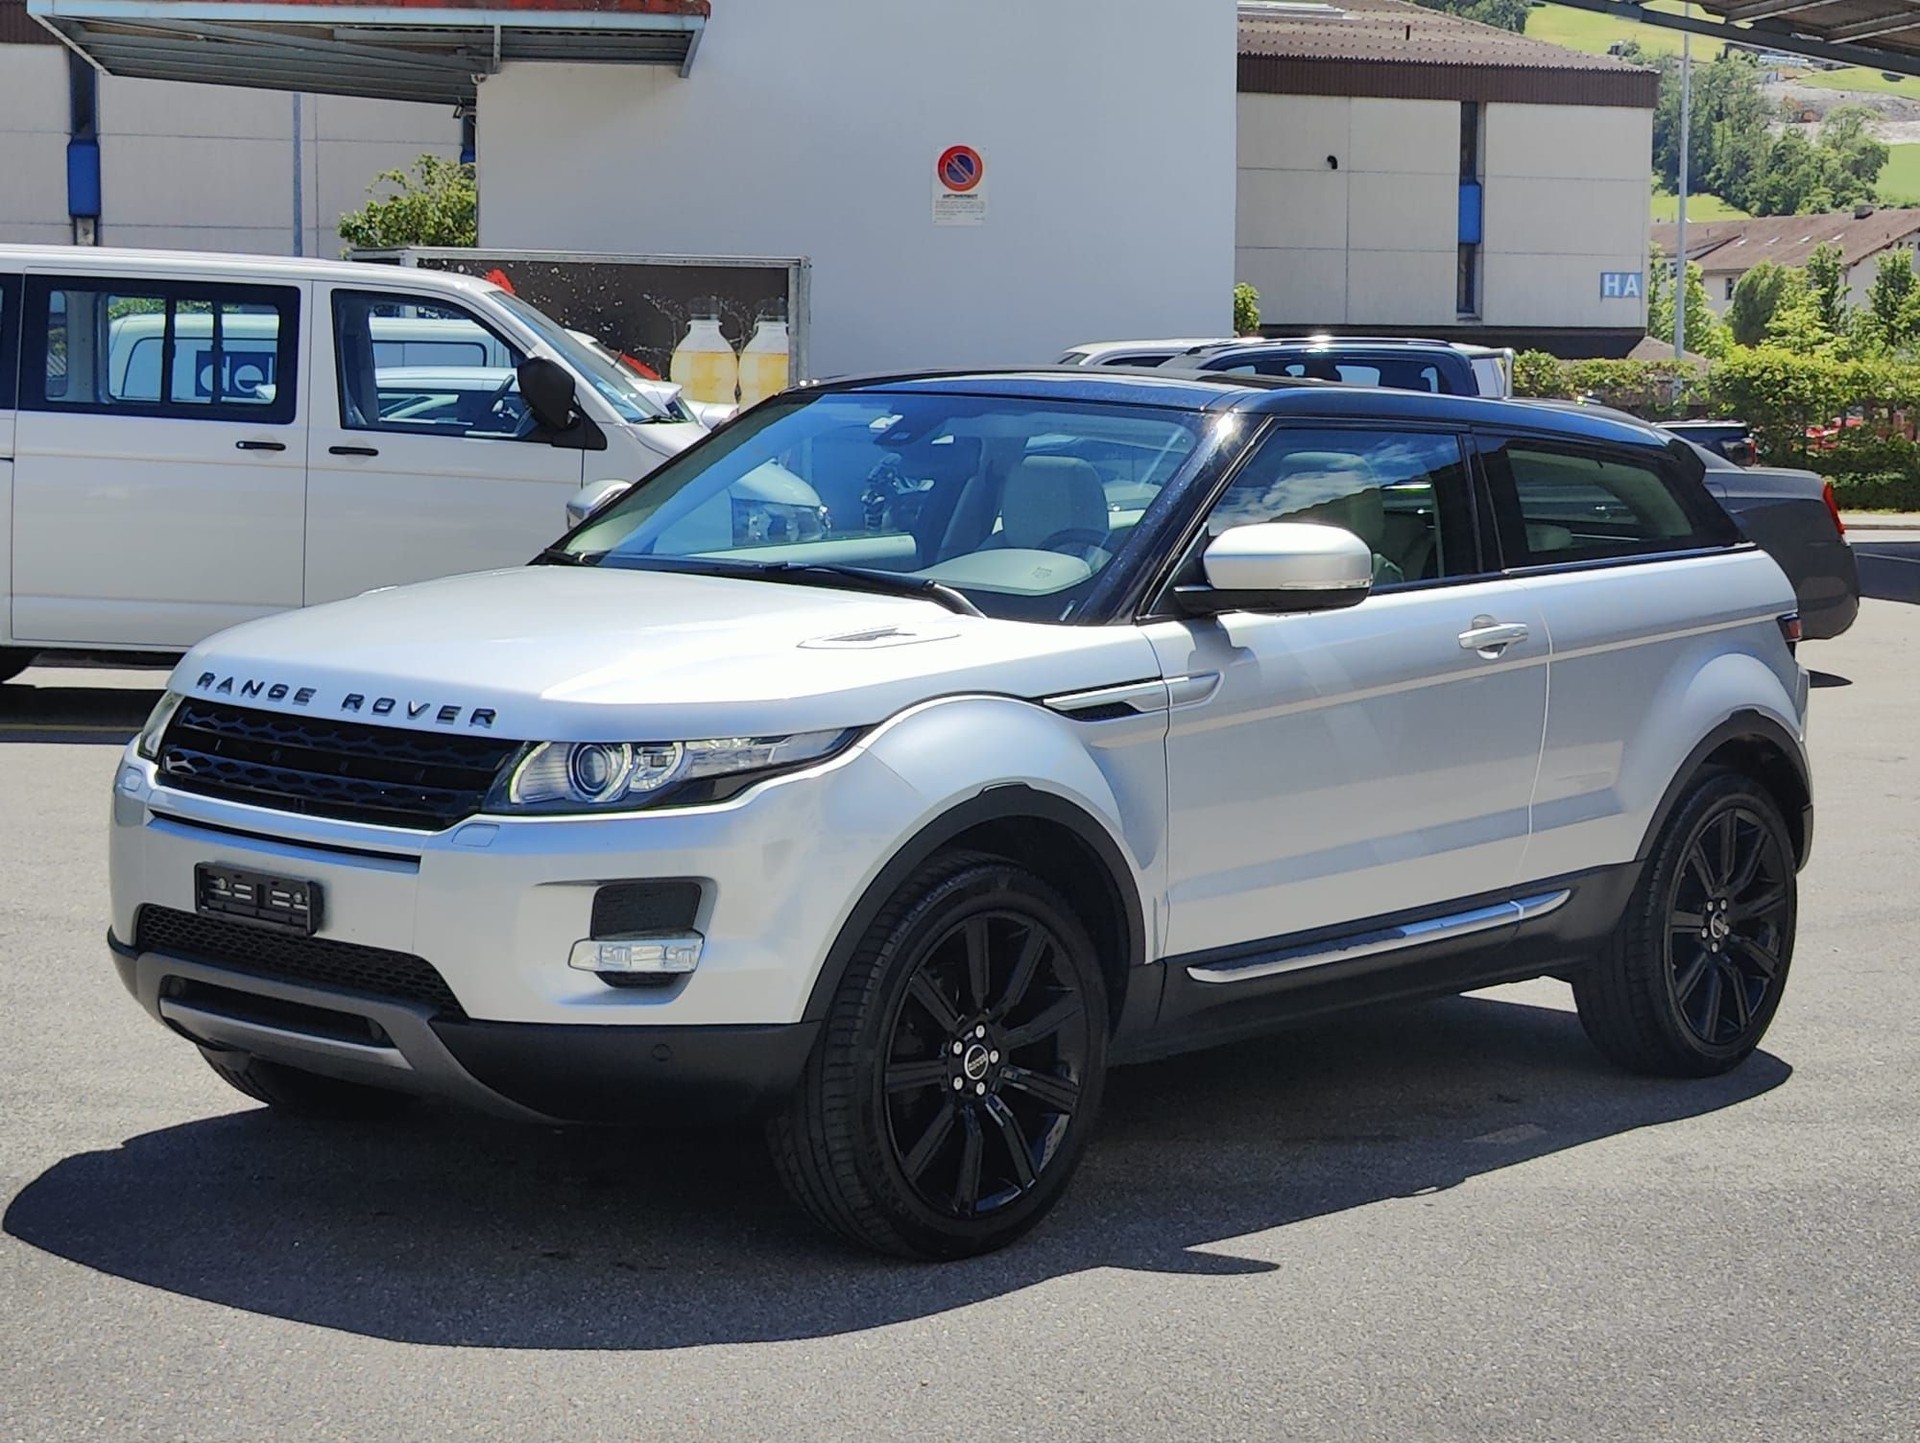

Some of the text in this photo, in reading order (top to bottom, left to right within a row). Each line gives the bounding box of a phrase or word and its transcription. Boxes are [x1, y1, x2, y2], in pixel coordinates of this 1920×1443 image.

[1603, 274, 1640, 296] HA
[196, 671, 497, 727] RANGE ROVER
